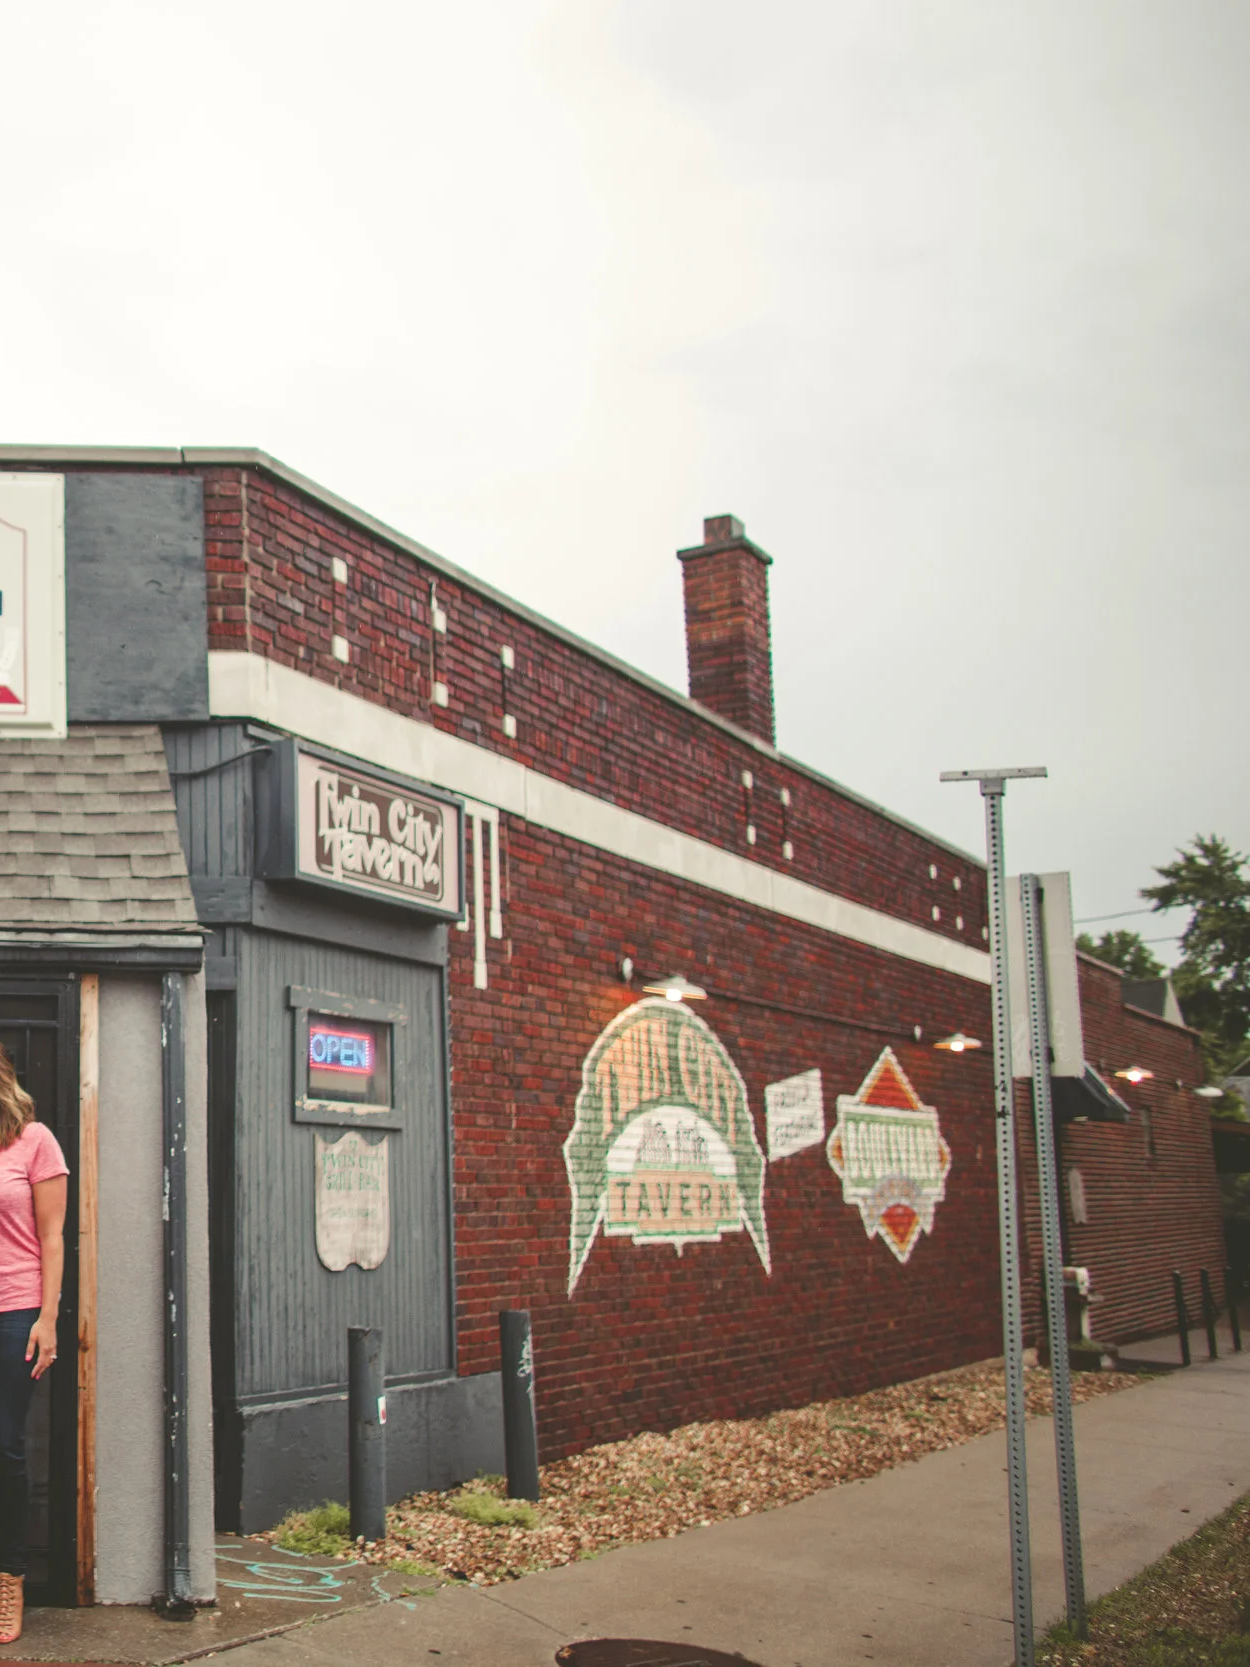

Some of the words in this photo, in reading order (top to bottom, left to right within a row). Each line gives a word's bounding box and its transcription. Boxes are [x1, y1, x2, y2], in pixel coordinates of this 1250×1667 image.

[311, 772, 381, 837] Twin
[387, 798, 443, 885] City
[318, 826, 425, 890] Tavern
[311, 1033, 368, 1069] OPEN
[595, 1018, 671, 1141] TWIN
[677, 1023, 738, 1149] CITY
[615, 1181, 732, 1218] TAVERN
